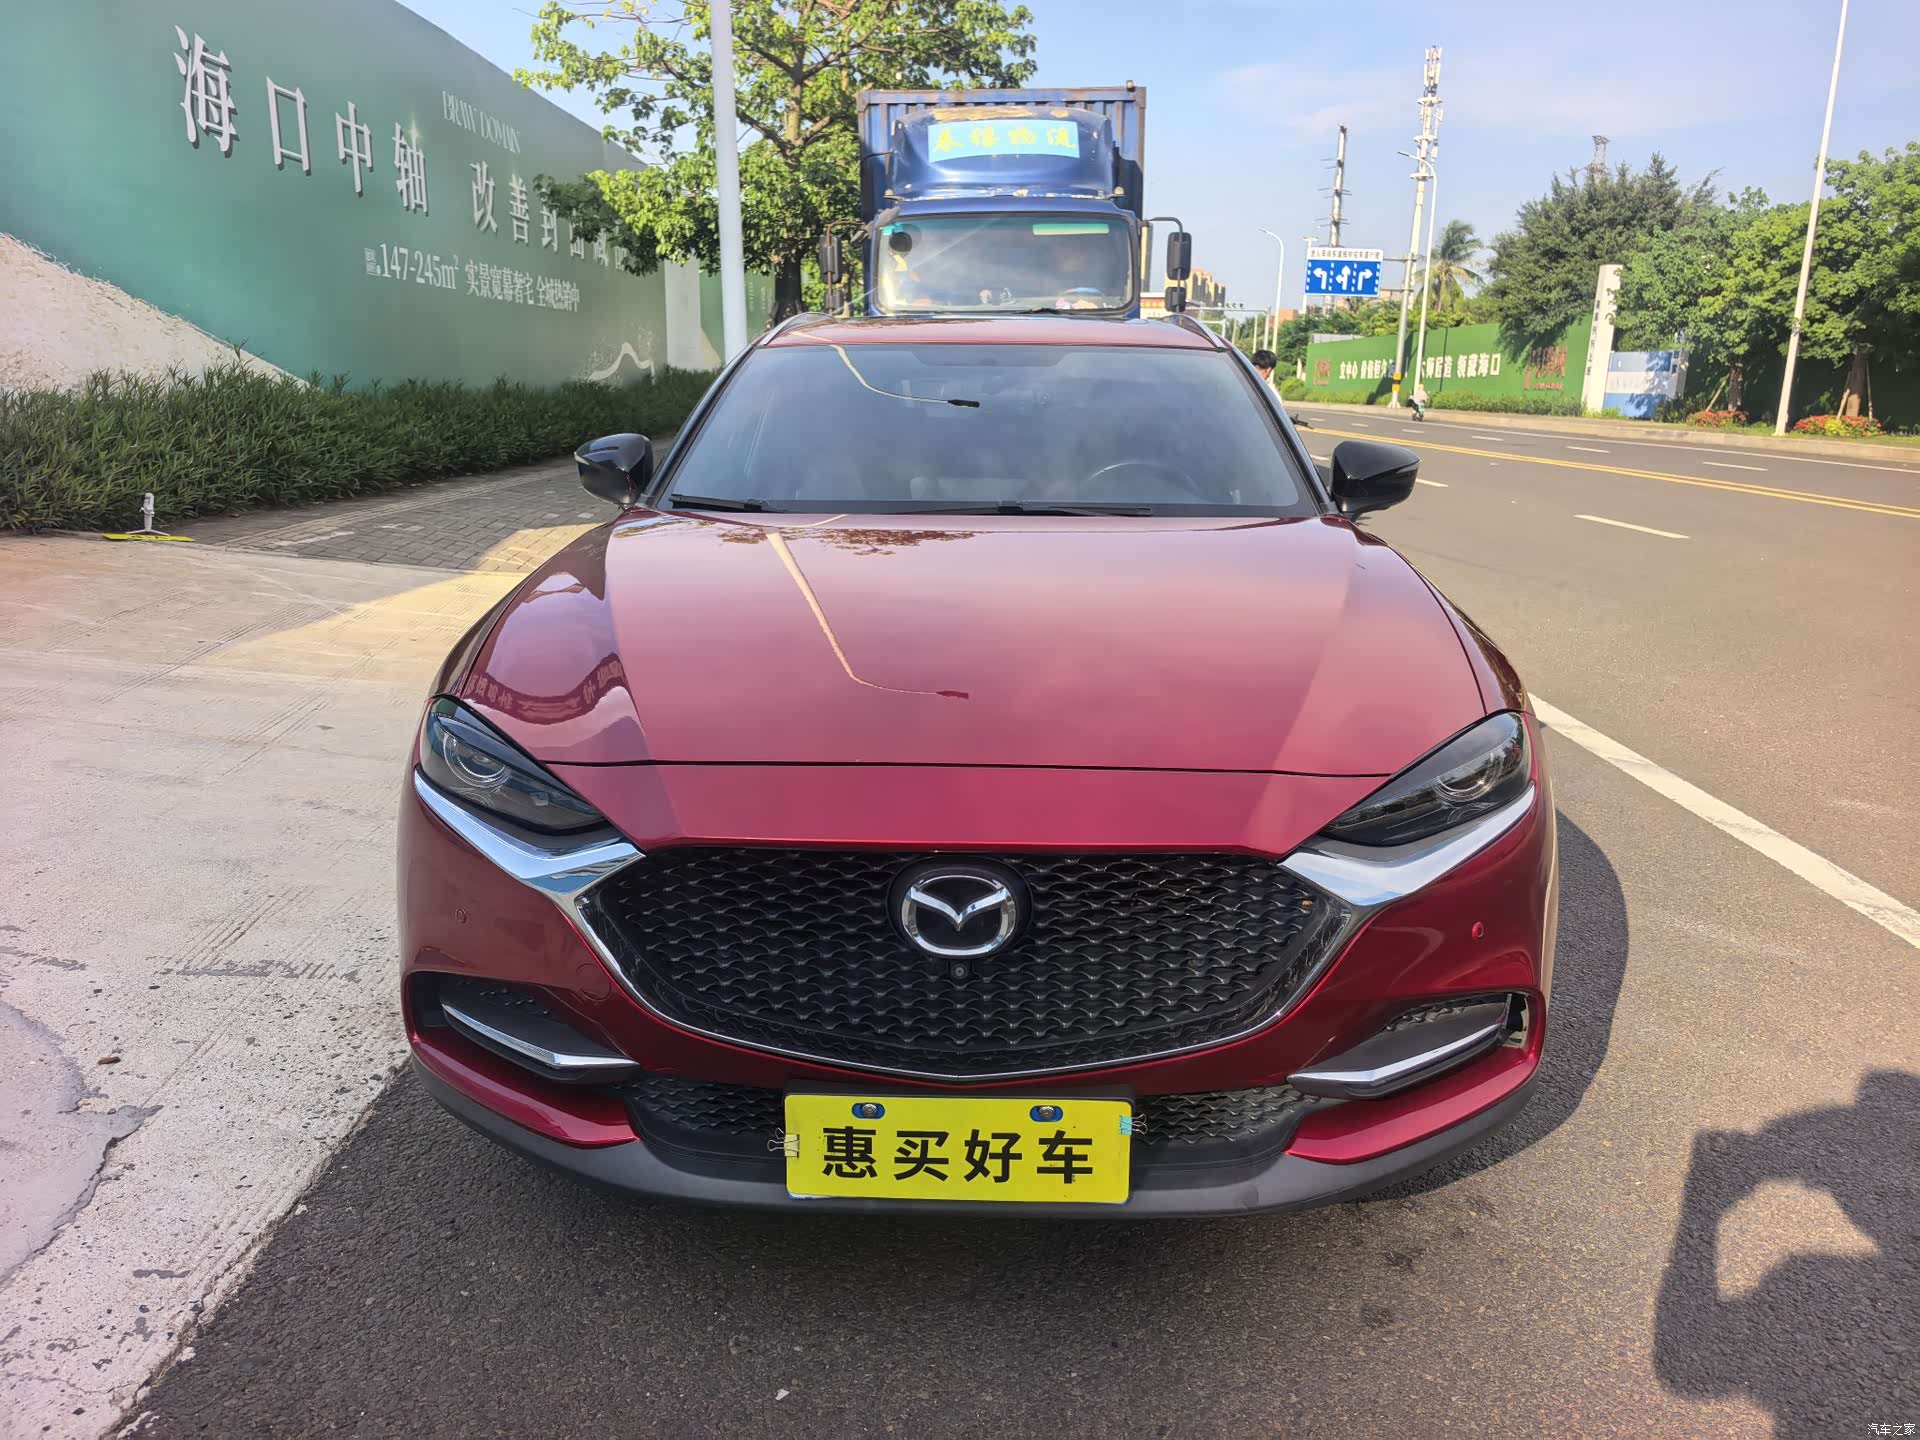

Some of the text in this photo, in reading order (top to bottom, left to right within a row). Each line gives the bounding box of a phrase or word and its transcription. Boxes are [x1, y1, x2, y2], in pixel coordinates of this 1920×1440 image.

[174, 25, 429, 213] 海口中轴
[822, 1126, 1093, 1184] 惠买好车
